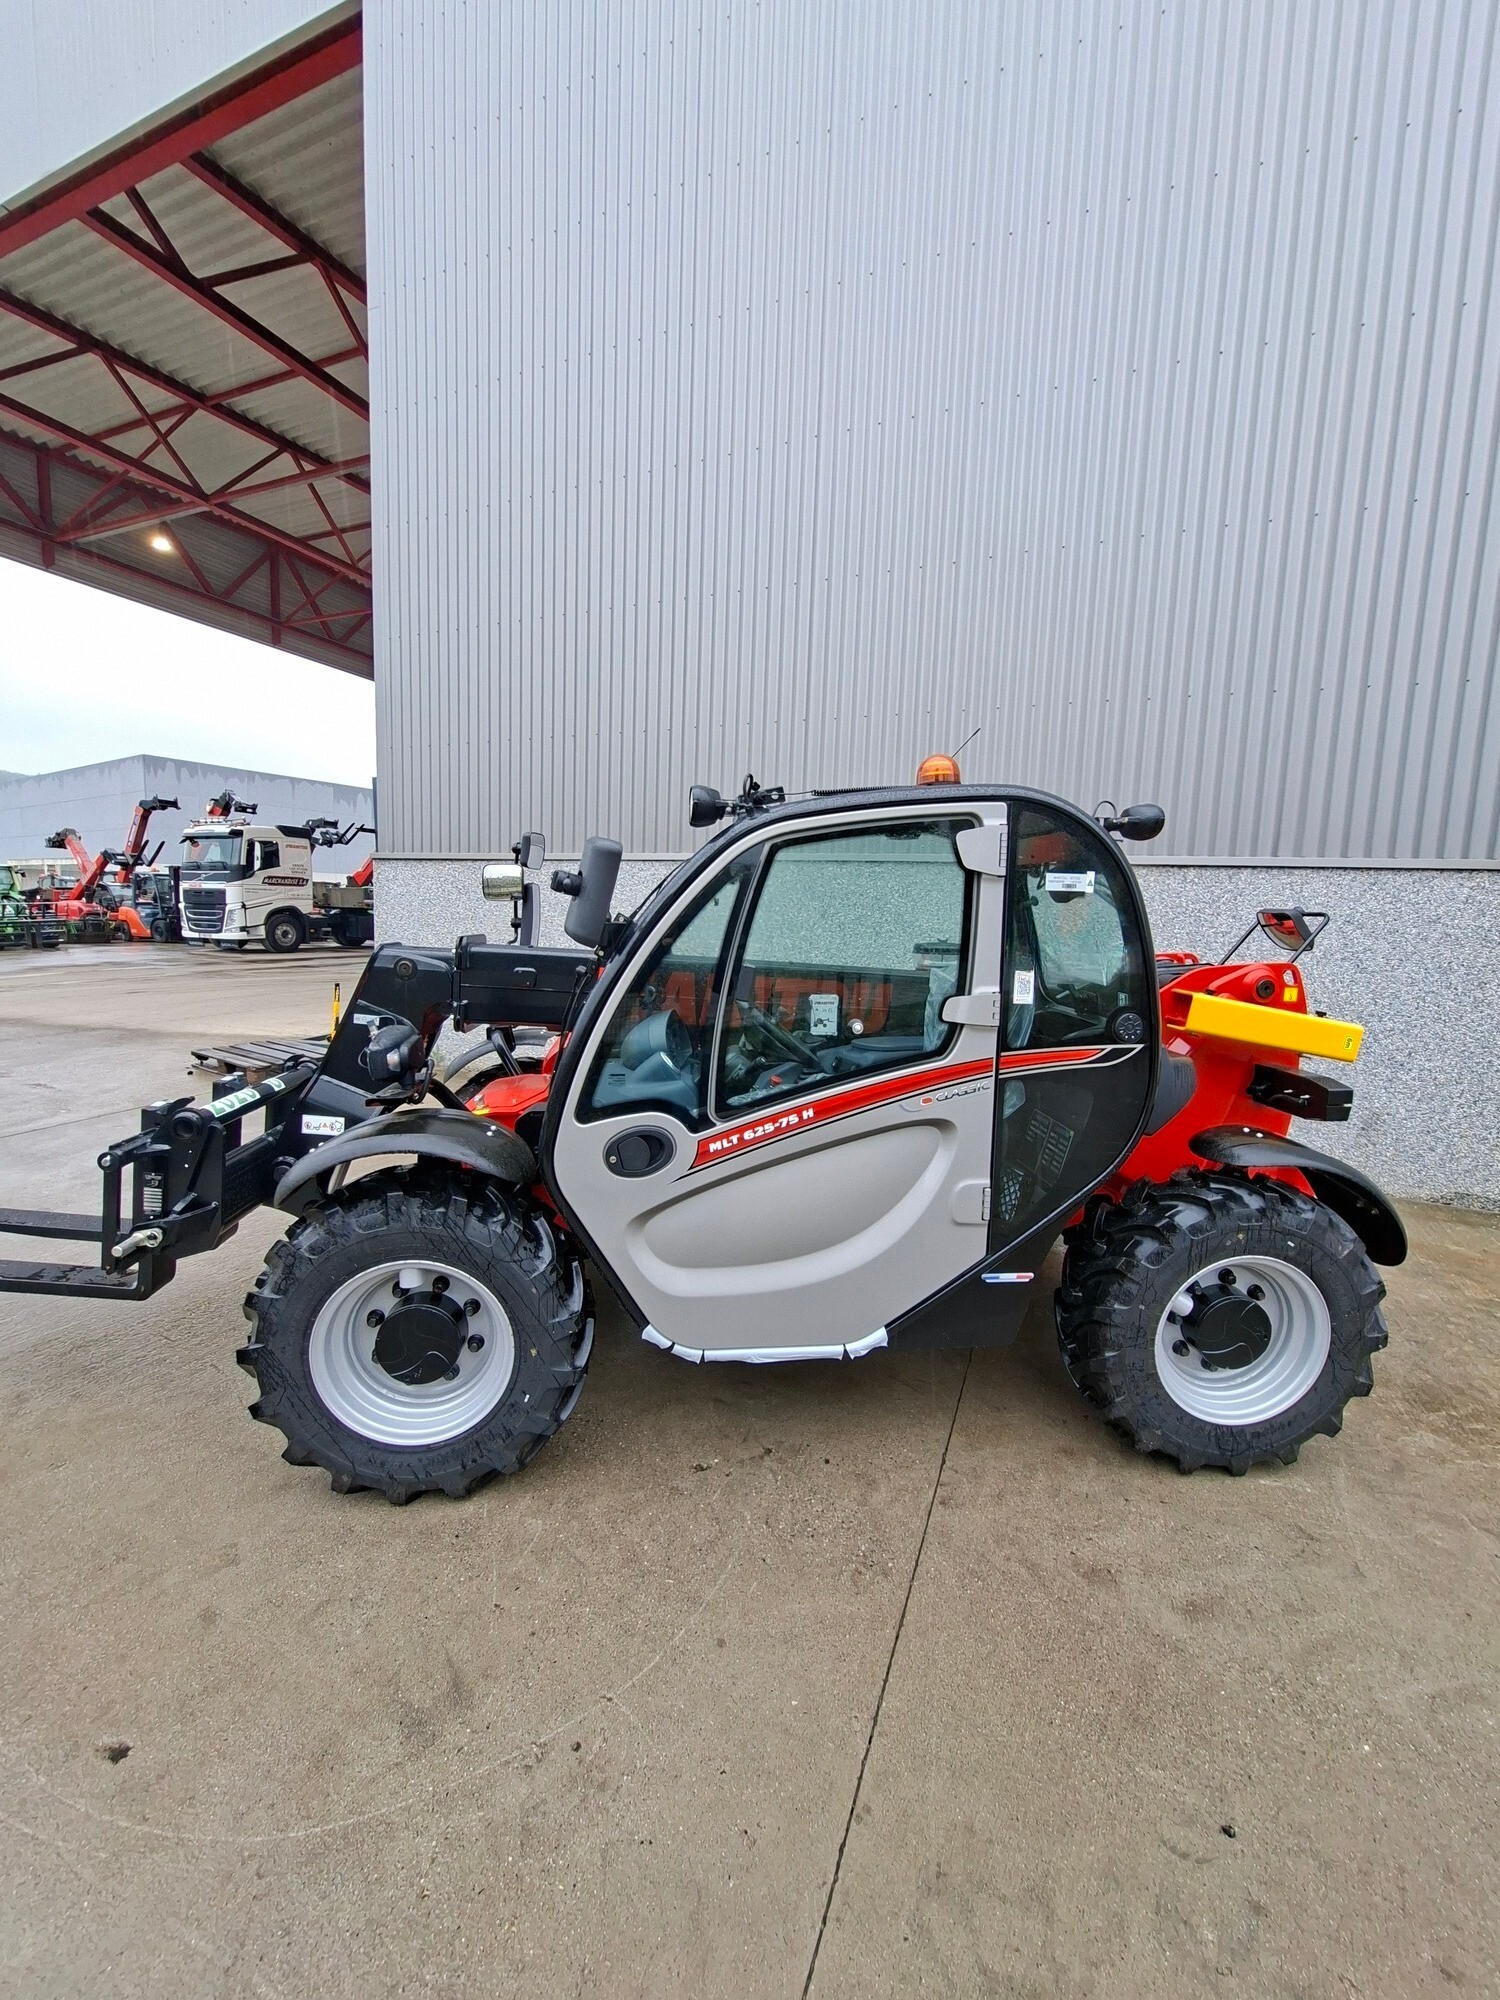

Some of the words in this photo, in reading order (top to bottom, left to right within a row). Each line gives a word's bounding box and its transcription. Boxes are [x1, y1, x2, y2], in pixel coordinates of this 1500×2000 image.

[263, 877, 298, 885] MARCHANDISE
[935, 1081, 991, 1102] CLASSIC
[709, 1134, 740, 1153] MLT
[743, 1113, 800, 1141] 625-75
[802, 1107, 815, 1120] H
